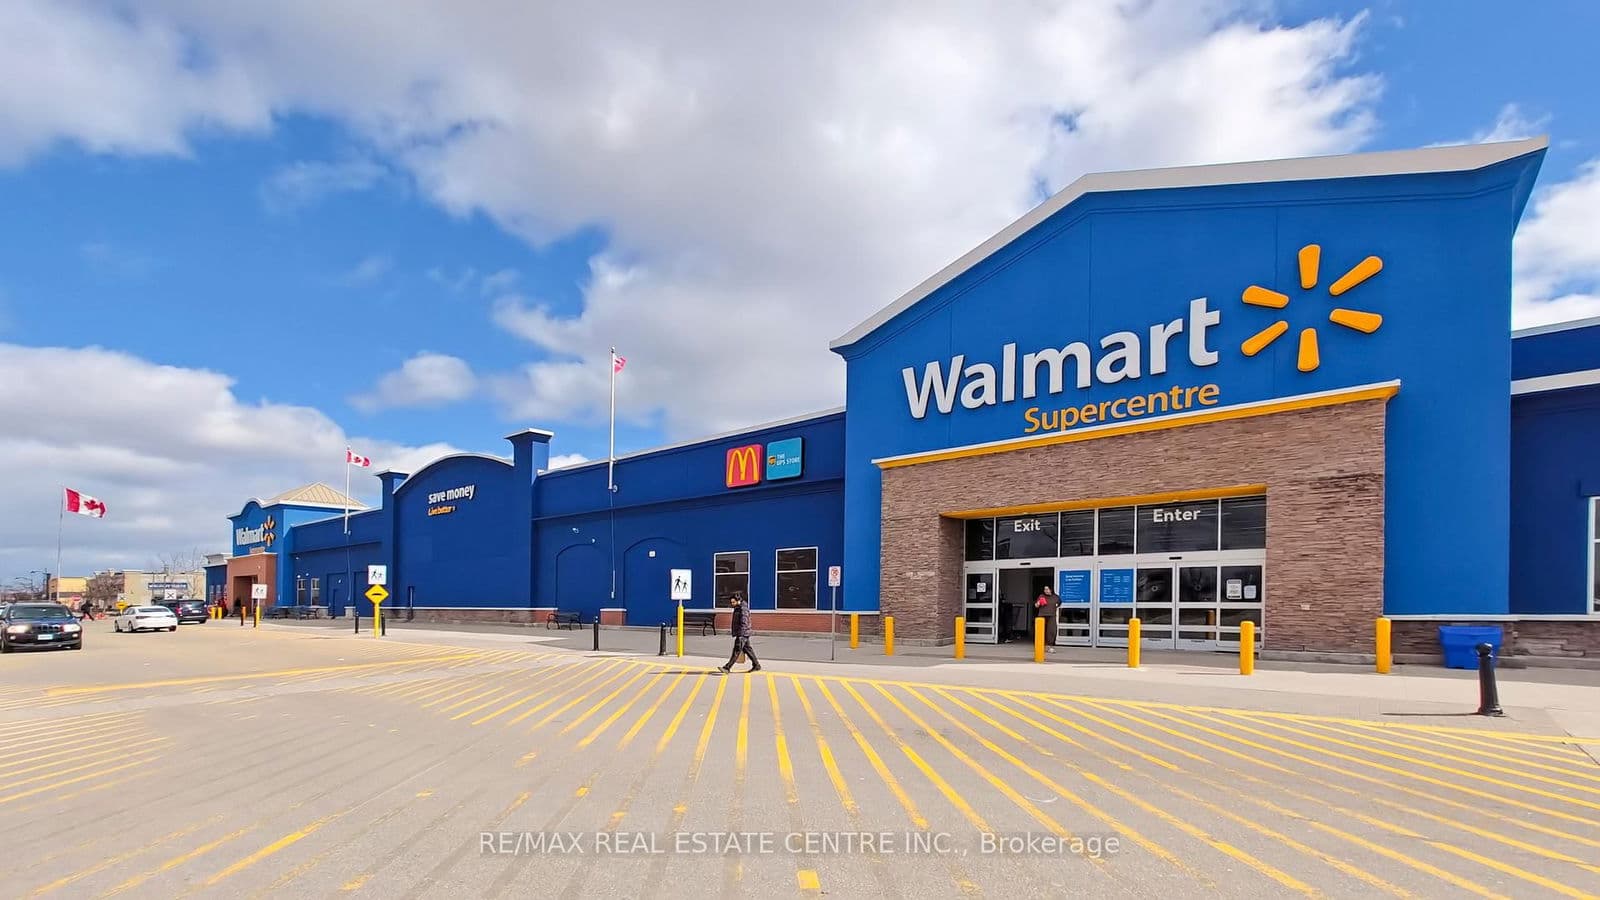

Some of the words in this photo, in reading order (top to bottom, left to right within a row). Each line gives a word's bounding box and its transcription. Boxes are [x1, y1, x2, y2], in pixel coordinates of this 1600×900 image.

[902, 297, 1220, 420] Walmart
[1024, 383, 1220, 433] Supercentre
[428, 491, 446, 504] save
[446, 484, 475, 500] money
[1013, 519, 1041, 533] Exit
[1152, 508, 1201, 523] Enter
[235, 522, 264, 546] Walmart
